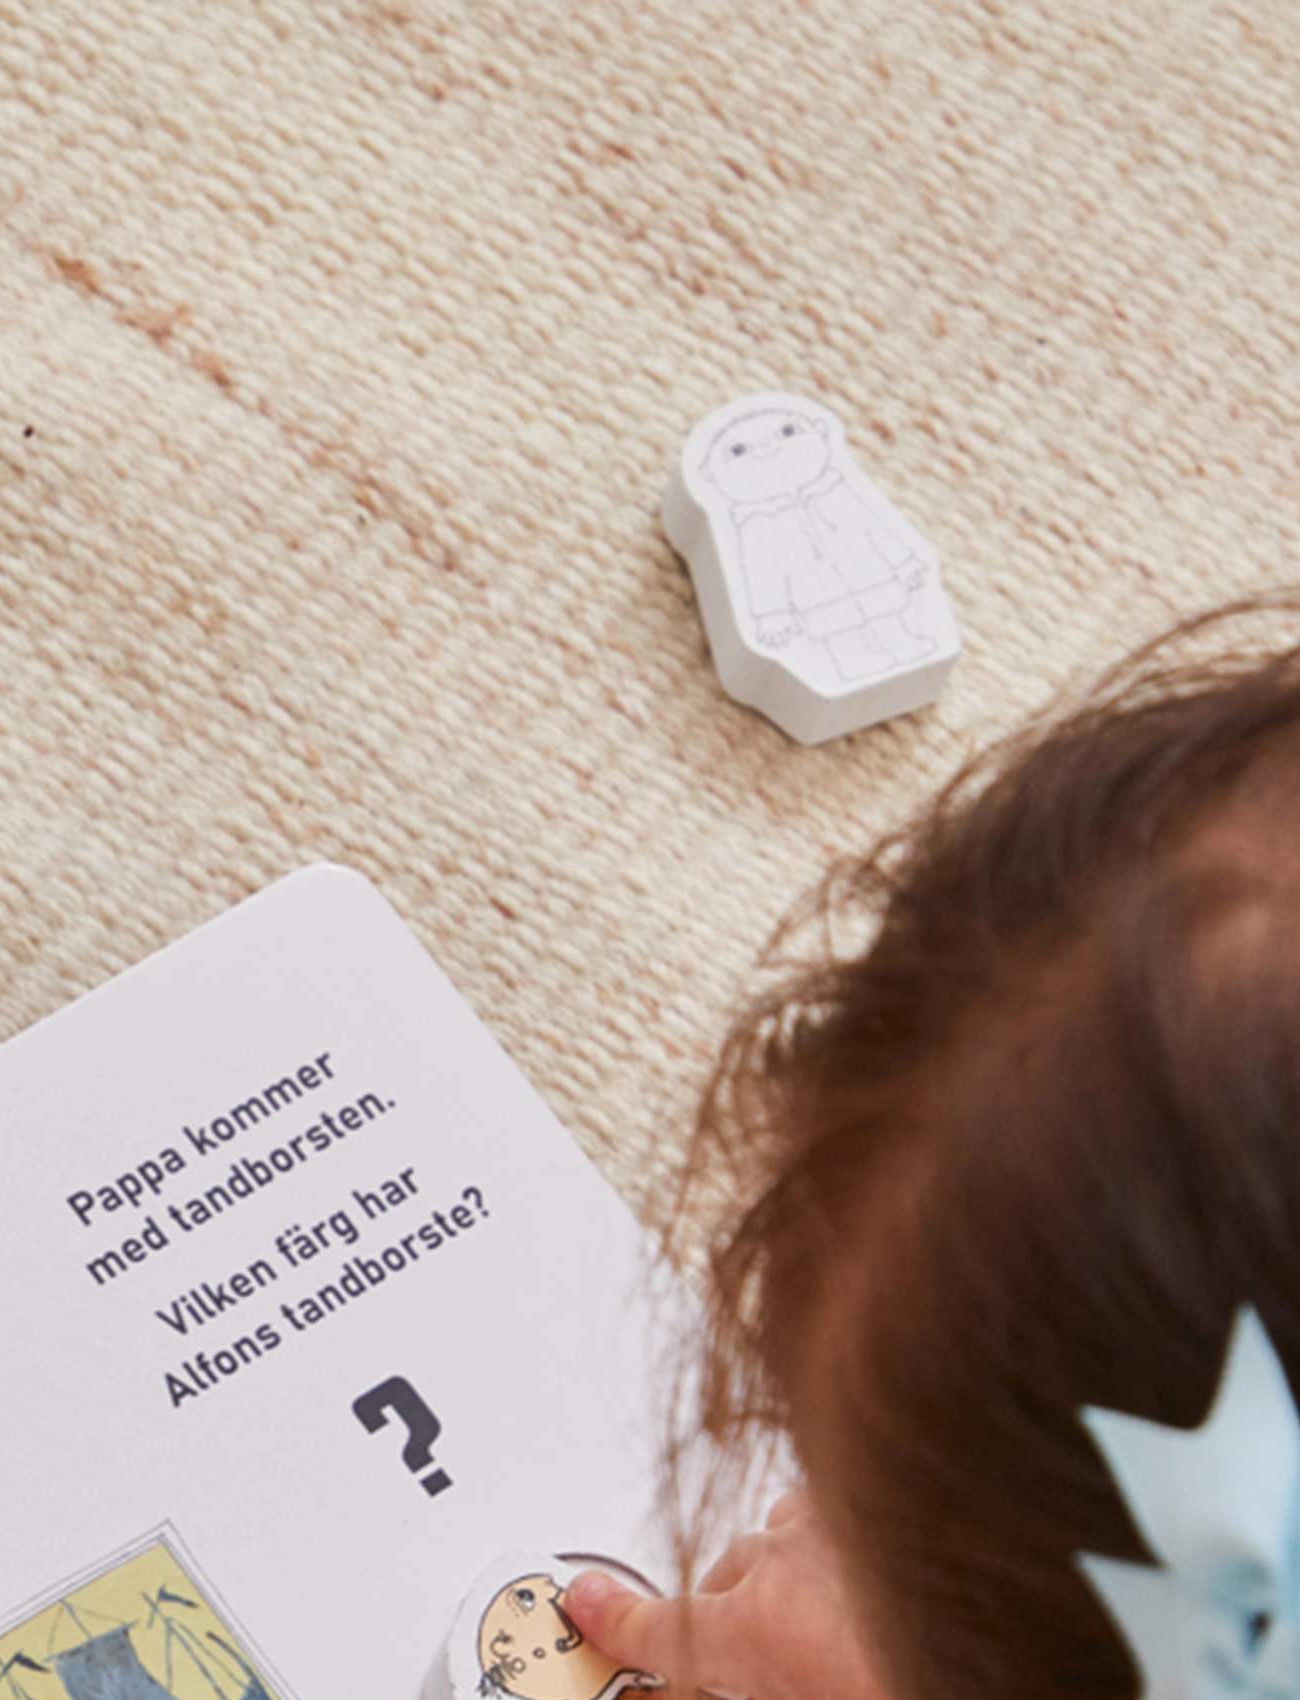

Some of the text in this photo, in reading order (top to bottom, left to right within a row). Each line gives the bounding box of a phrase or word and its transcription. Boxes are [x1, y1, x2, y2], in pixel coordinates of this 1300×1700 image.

[65, 1052, 334, 1227] Pappa kommer
[85, 1093, 396, 1286] med tandborsten.
[154, 1167, 419, 1336] Vilken färg har
[164, 1186, 490, 1409] Alfons tandborste?
[351, 1375, 454, 1498] ?
